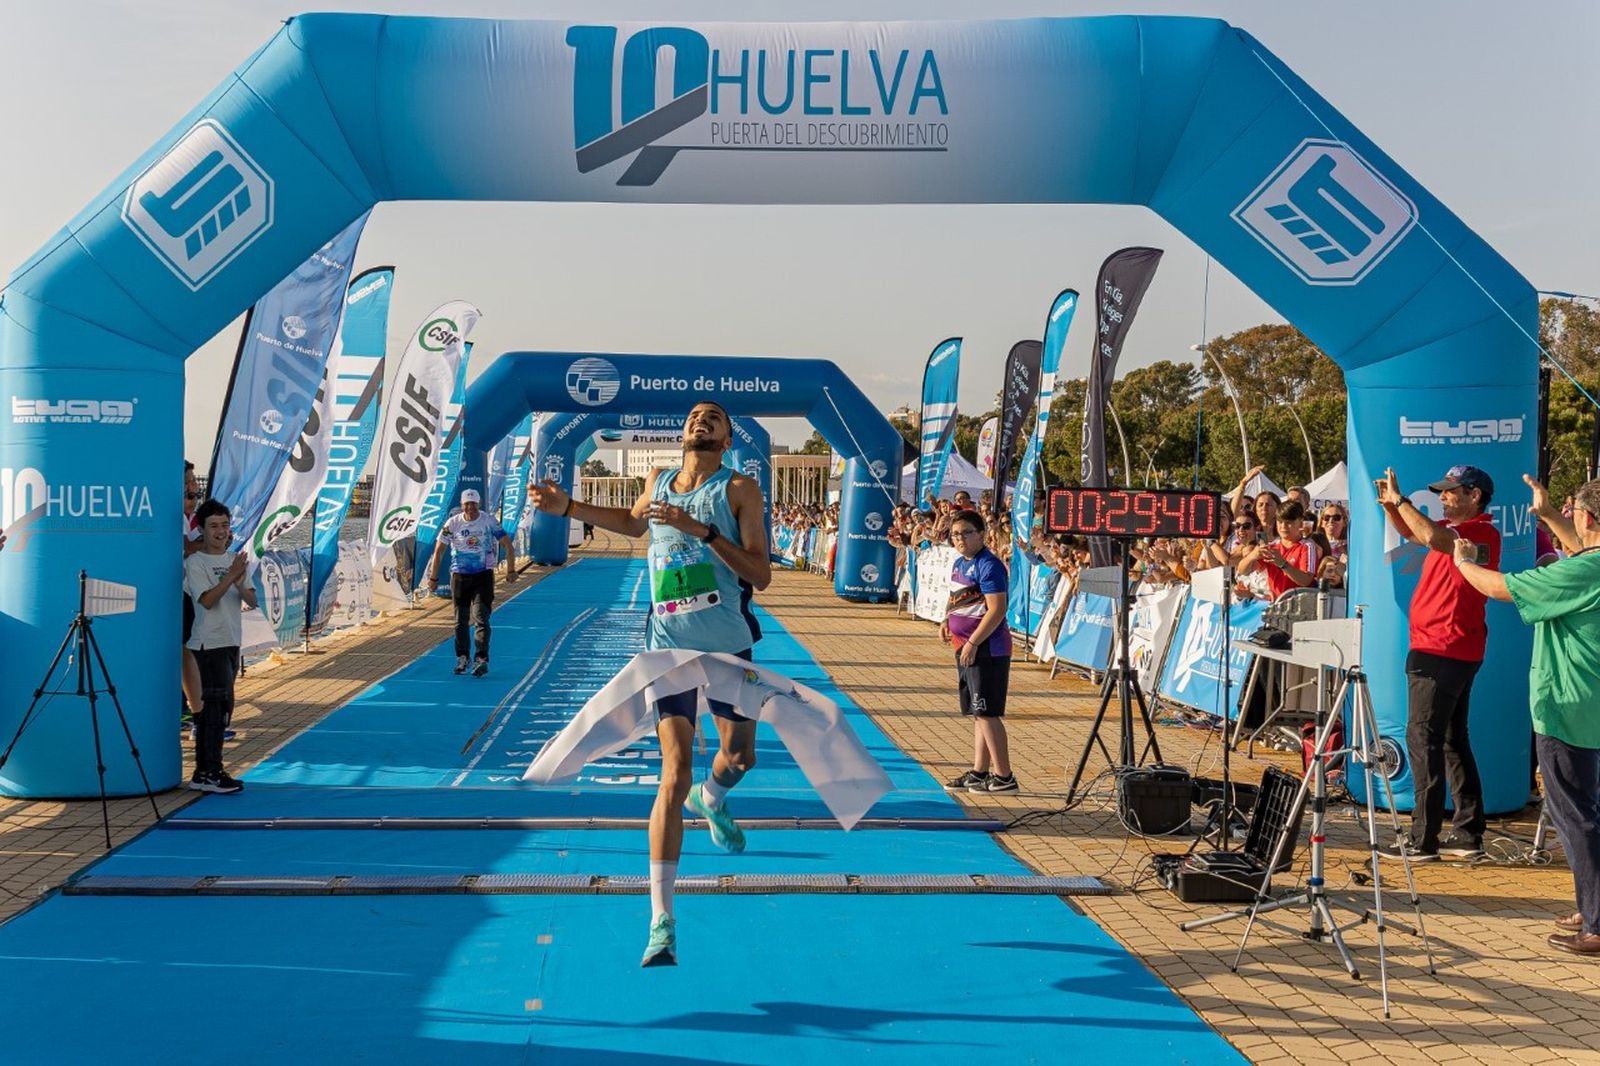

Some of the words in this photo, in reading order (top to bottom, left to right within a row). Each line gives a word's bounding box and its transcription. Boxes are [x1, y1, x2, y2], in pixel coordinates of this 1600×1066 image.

[710, 48, 949, 116] HUELVA
[711, 121, 769, 145] PUERTA
[774, 122, 802, 145] DEL
[808, 122, 949, 147] DESCUBRIMIENTO
[256, 332, 282, 348] Puerto
[285, 341, 295, 350] de
[296, 345, 324, 358] Huelva
[427, 326, 460, 347] CSIF
[630, 374, 687, 392] Puerto
[692, 374, 716, 391] de
[720, 377, 780, 393] Huelva
[50, 416, 92, 424] WEAR
[389, 372, 441, 484] CSIF
[648, 418, 685, 428] HUELV
[232, 430, 260, 444] Puerto
[632, 434, 675, 443] ATLANTIC
[676, 435, 684, 443] C
[1401, 437, 1446, 445] ACTIVE
[46, 485, 153, 517] HUELVA
[1049, 489, 1215, 536] 00:29:40
[386, 516, 415, 533] CSIF
